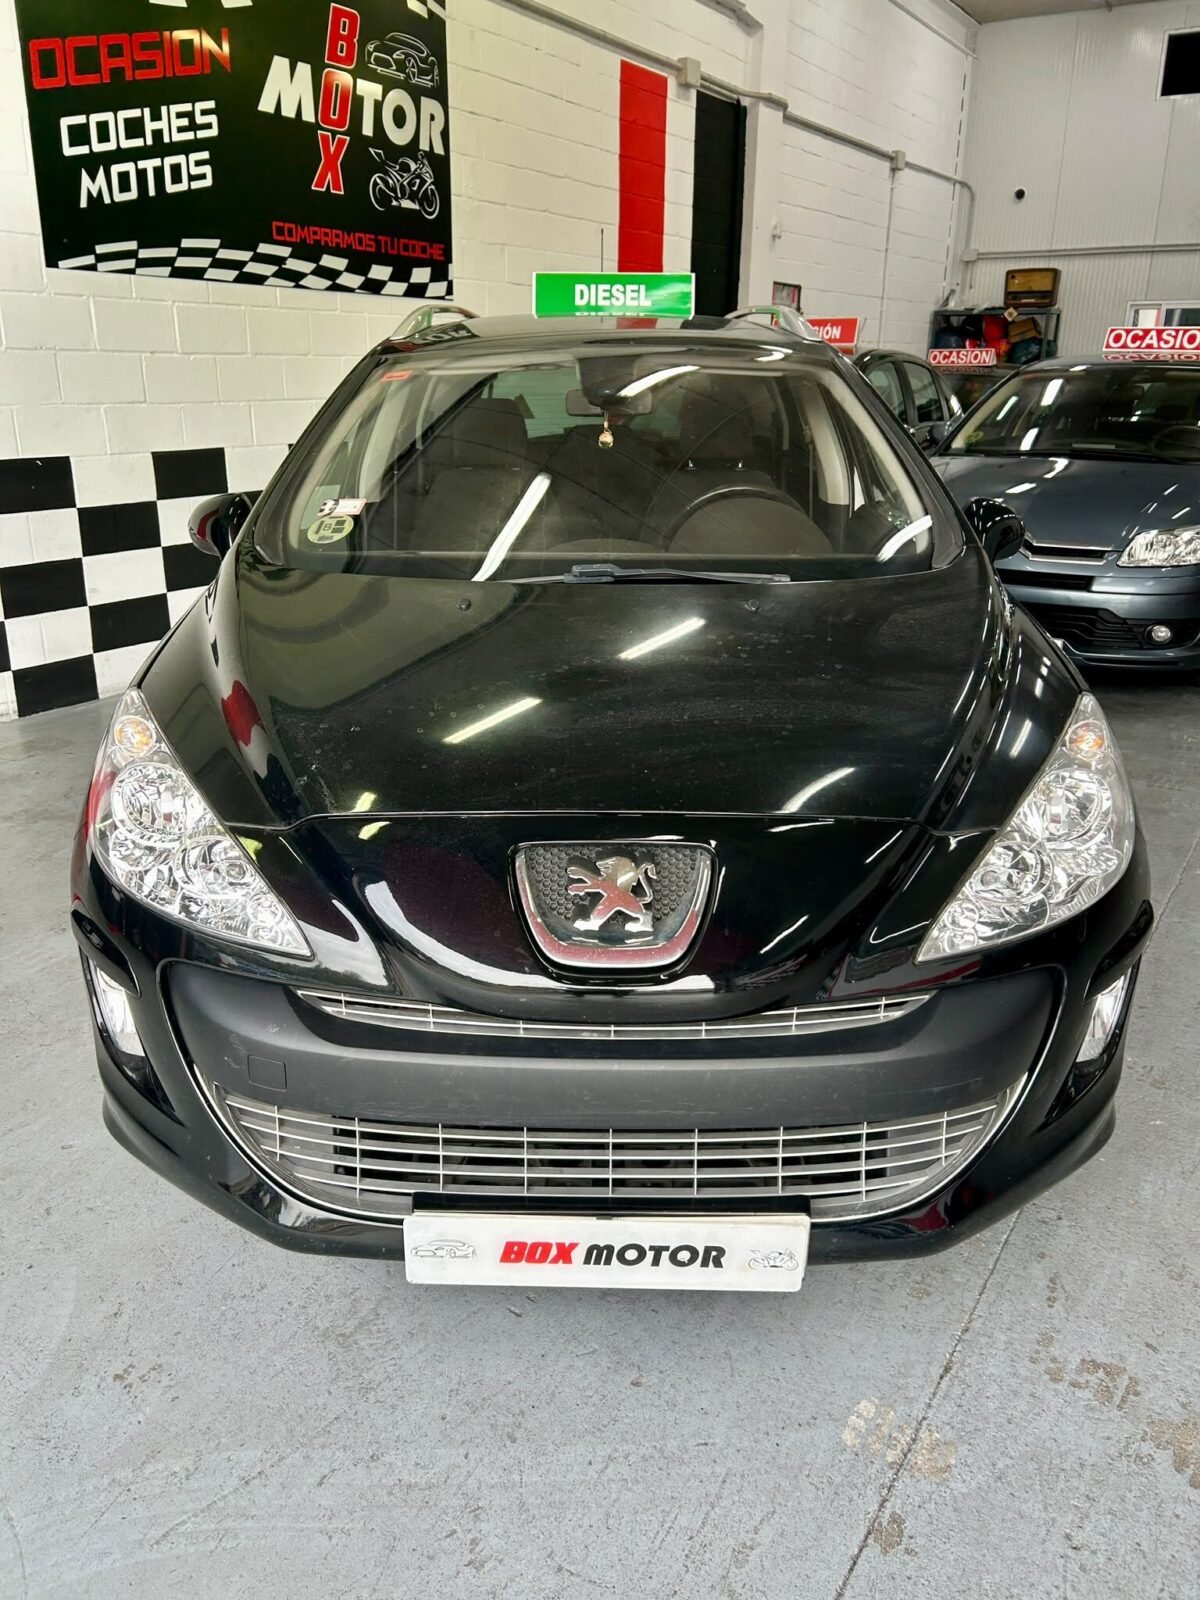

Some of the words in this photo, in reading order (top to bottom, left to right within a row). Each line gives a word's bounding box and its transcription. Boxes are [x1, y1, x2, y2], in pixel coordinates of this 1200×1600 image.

[29, 27, 231, 89] OCASION
[312, 3, 360, 194] BOX
[60, 100, 218, 156] COCHES
[79, 151, 213, 208] MOTOS
[271, 221, 376, 252] COMPRAMOS
[378, 235, 398, 254] TU
[400, 239, 445, 260] COCHE
[574, 284, 652, 306] DIESEL
[929, 350, 992, 364] OCASION
[500, 1241, 580, 1264] BOX
[583, 1243, 726, 1269] MOTOR
